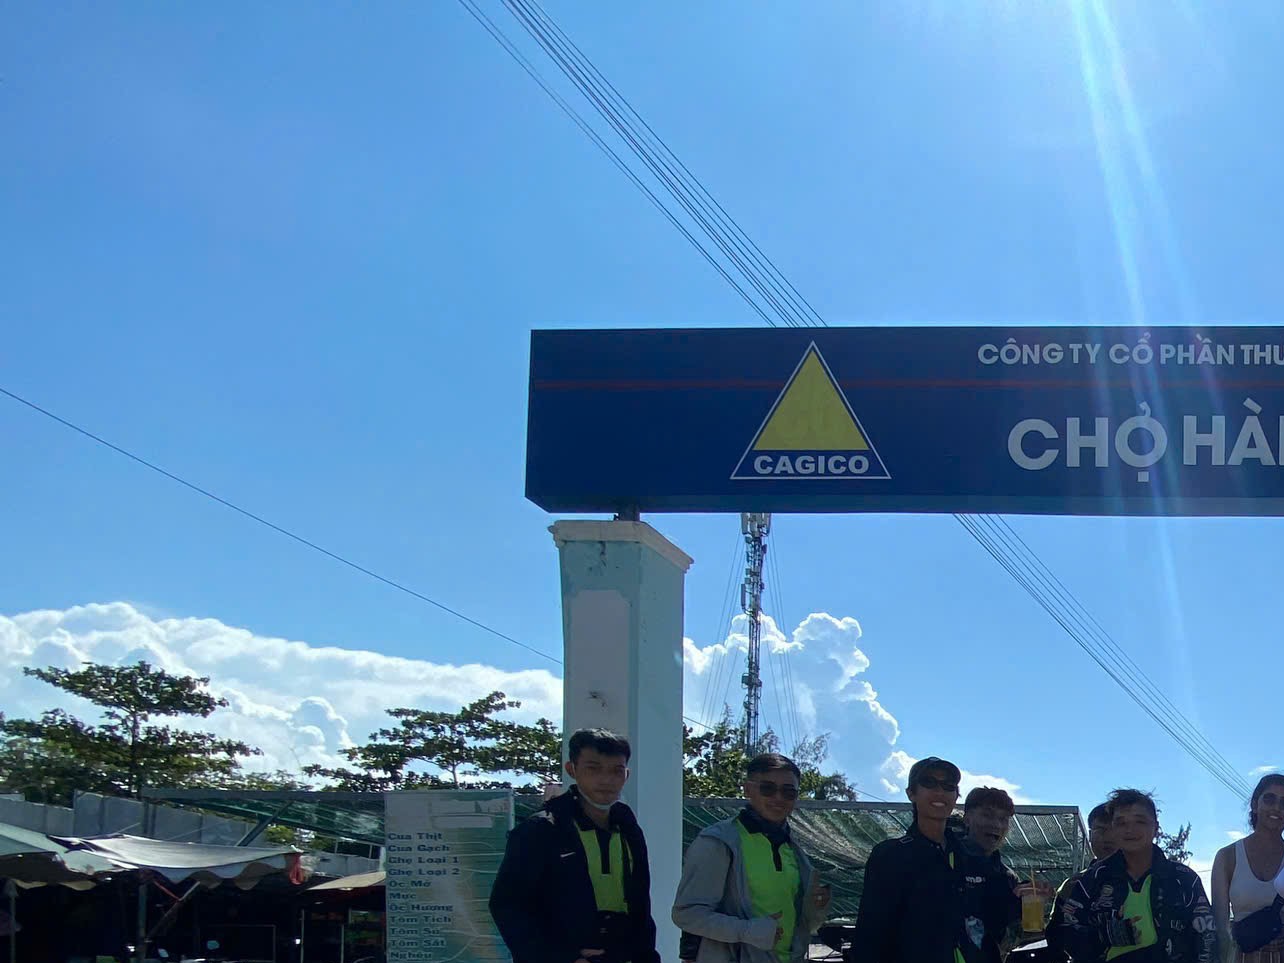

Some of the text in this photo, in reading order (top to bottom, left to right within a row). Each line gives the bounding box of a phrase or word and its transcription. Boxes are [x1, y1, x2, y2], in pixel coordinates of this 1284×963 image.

[977, 337, 1064, 364] CÔNG
[1069, 343, 1101, 364] TY
[1109, 331, 1154, 364] CỔ
[1160, 333, 1235, 365] PHẦN
[753, 455, 870, 474] CAGICO
[452, 856, 460, 864] 1
[451, 867, 461, 875] 2
